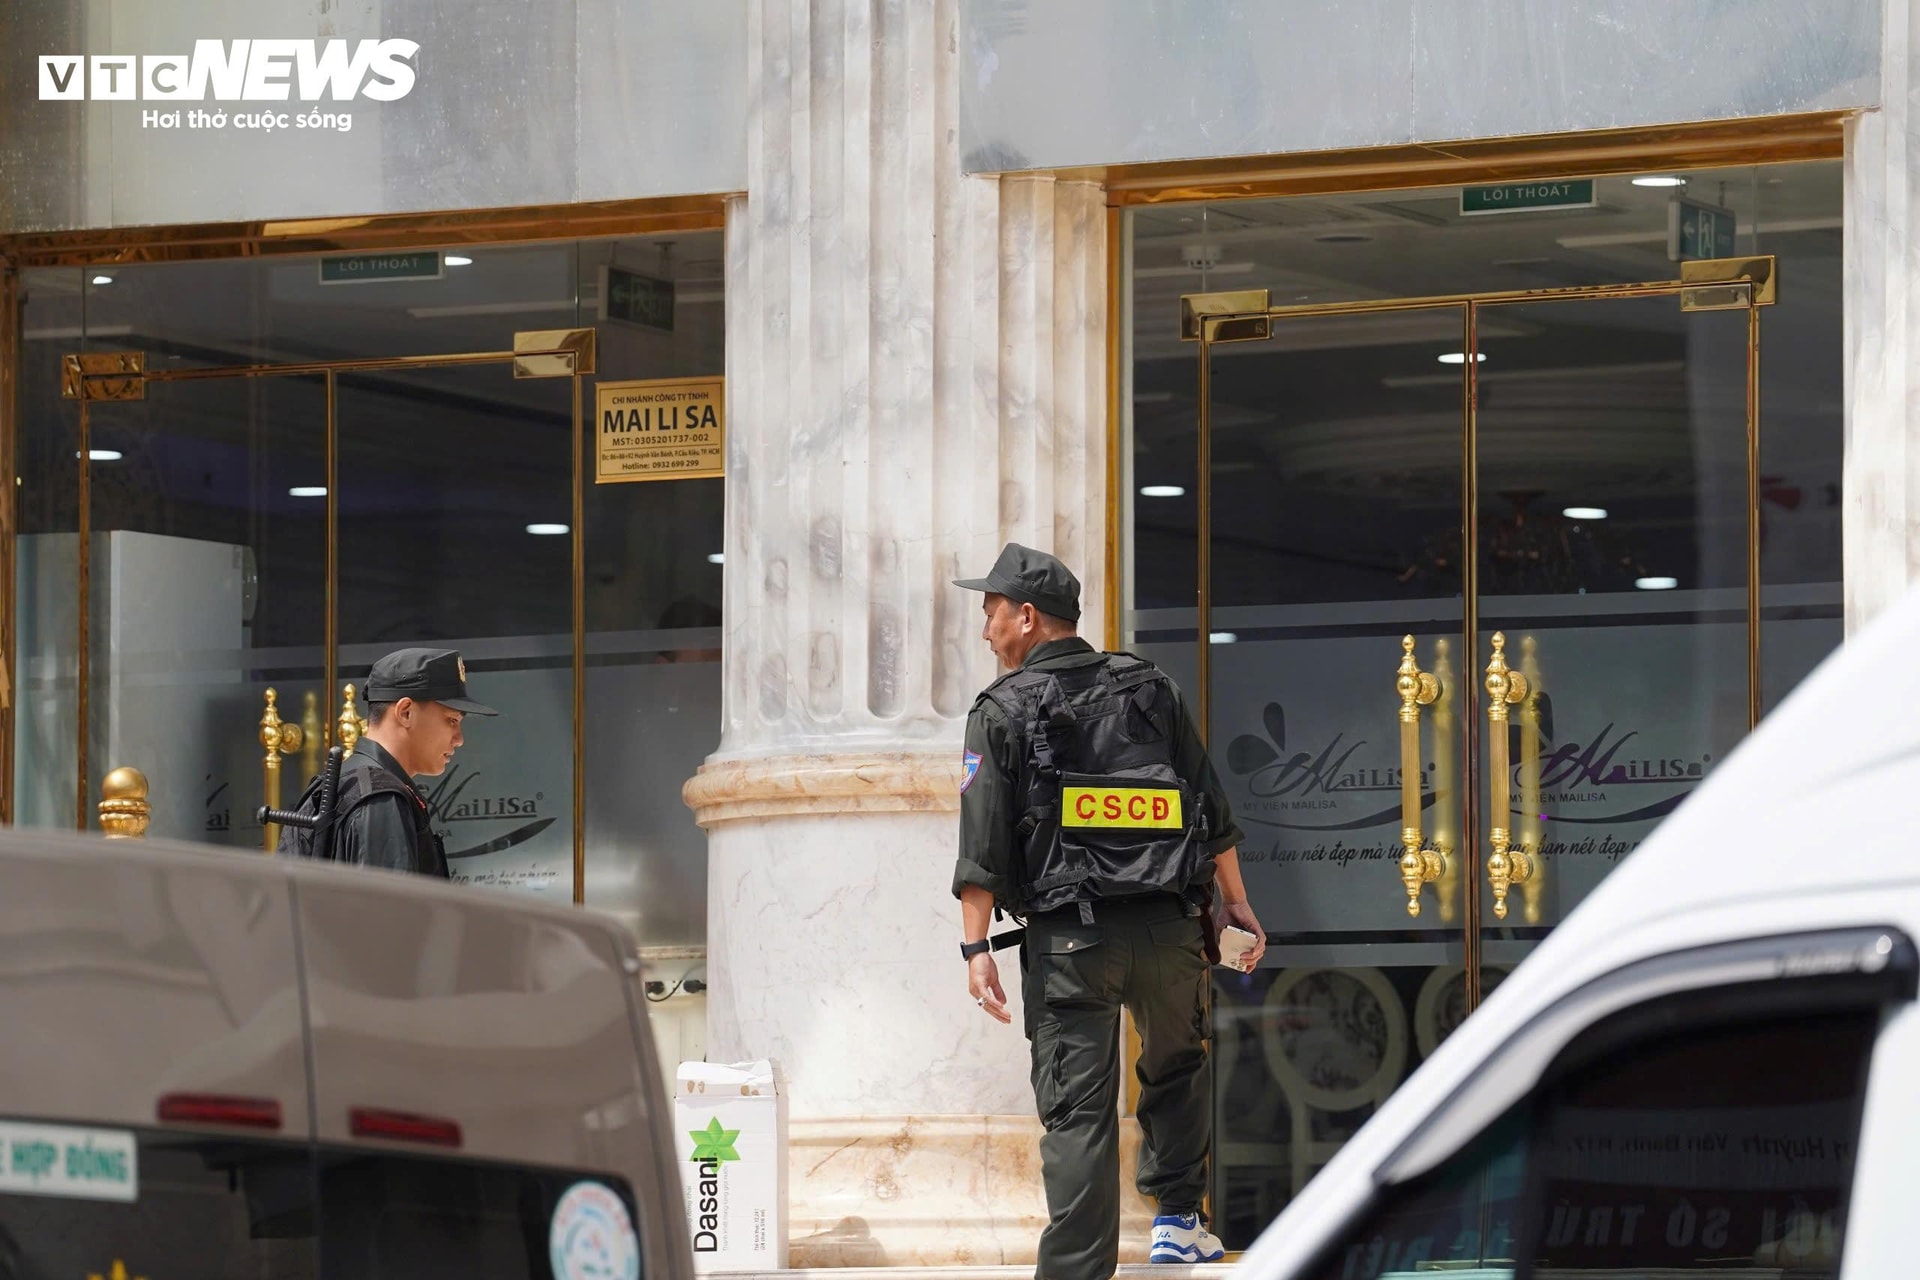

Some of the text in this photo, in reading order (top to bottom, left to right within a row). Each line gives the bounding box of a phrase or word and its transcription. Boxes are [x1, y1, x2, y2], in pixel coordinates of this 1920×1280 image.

[612, 392, 709, 405] CHI NHÁNH CÔNG TY TNHH
[603, 404, 718, 434] MAI LI SA
[612, 433, 709, 447] MST: 0305201737-002
[622, 463, 650, 471] Hotline:
[653, 461, 670, 469] 0932
[686, 459, 699, 467] 299
[1075, 793, 1170, 821] CSCĐ
[1292, 799, 1337, 810] MAILISA
[1559, 792, 1607, 803] MAILISA
[1328, 840, 1356, 868] đẹp
[1360, 842, 1387, 861] mà
[1569, 836, 1597, 855] nét
[1600, 834, 1629, 861] đẹp
[693, 1156, 718, 1253] Dasani
